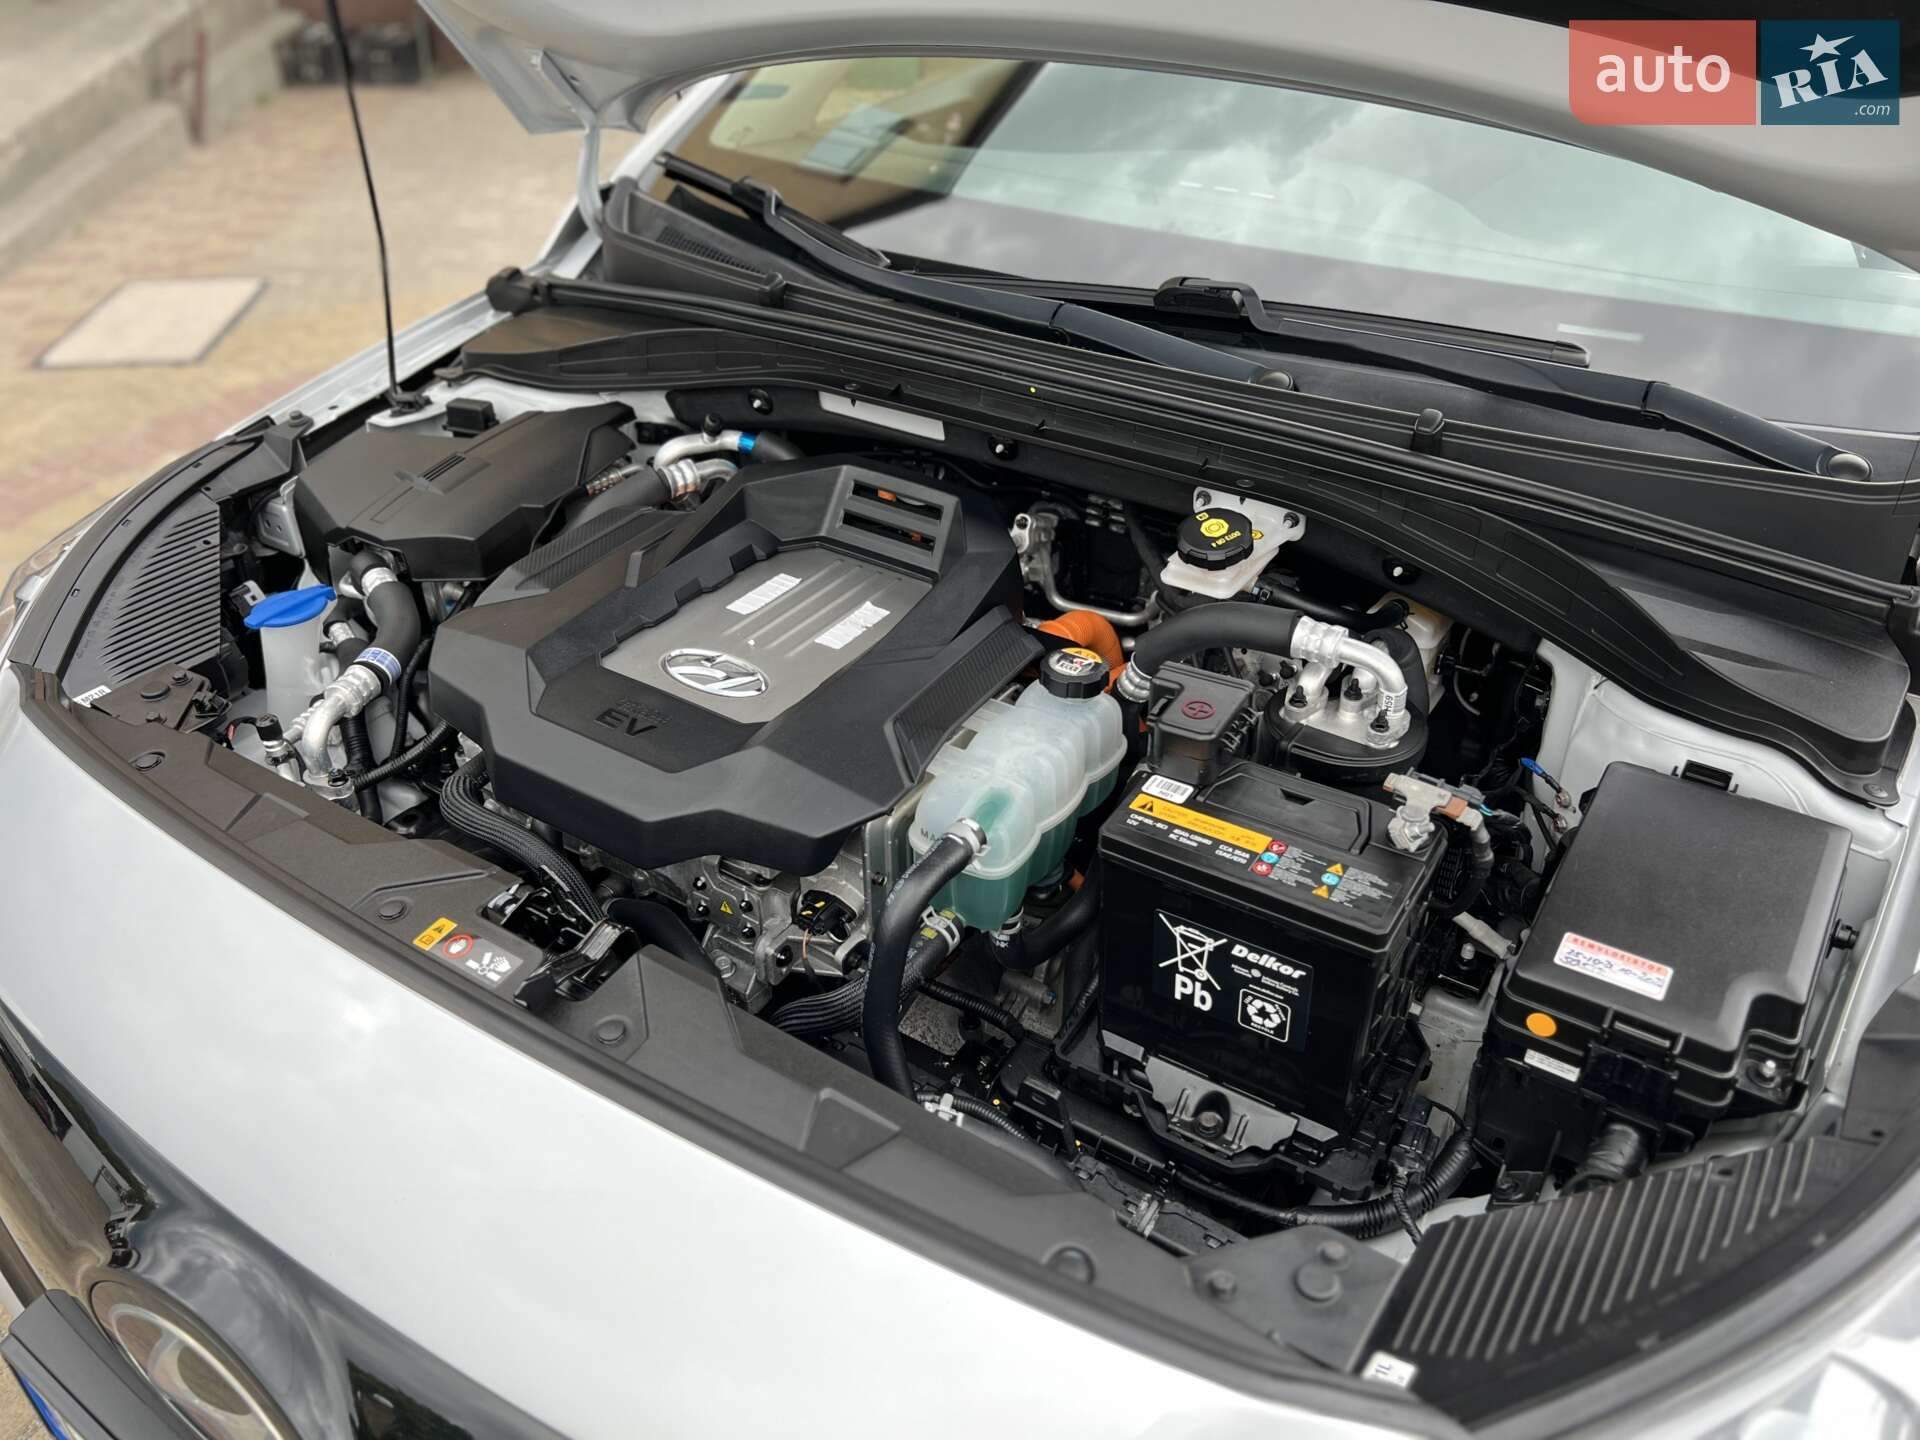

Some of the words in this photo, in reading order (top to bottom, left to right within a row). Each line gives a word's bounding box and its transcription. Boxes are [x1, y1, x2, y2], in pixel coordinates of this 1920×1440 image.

[595, 708, 658, 736] EV
[1231, 944, 1307, 979] Delkor
[1174, 973, 1213, 1012] Pb
